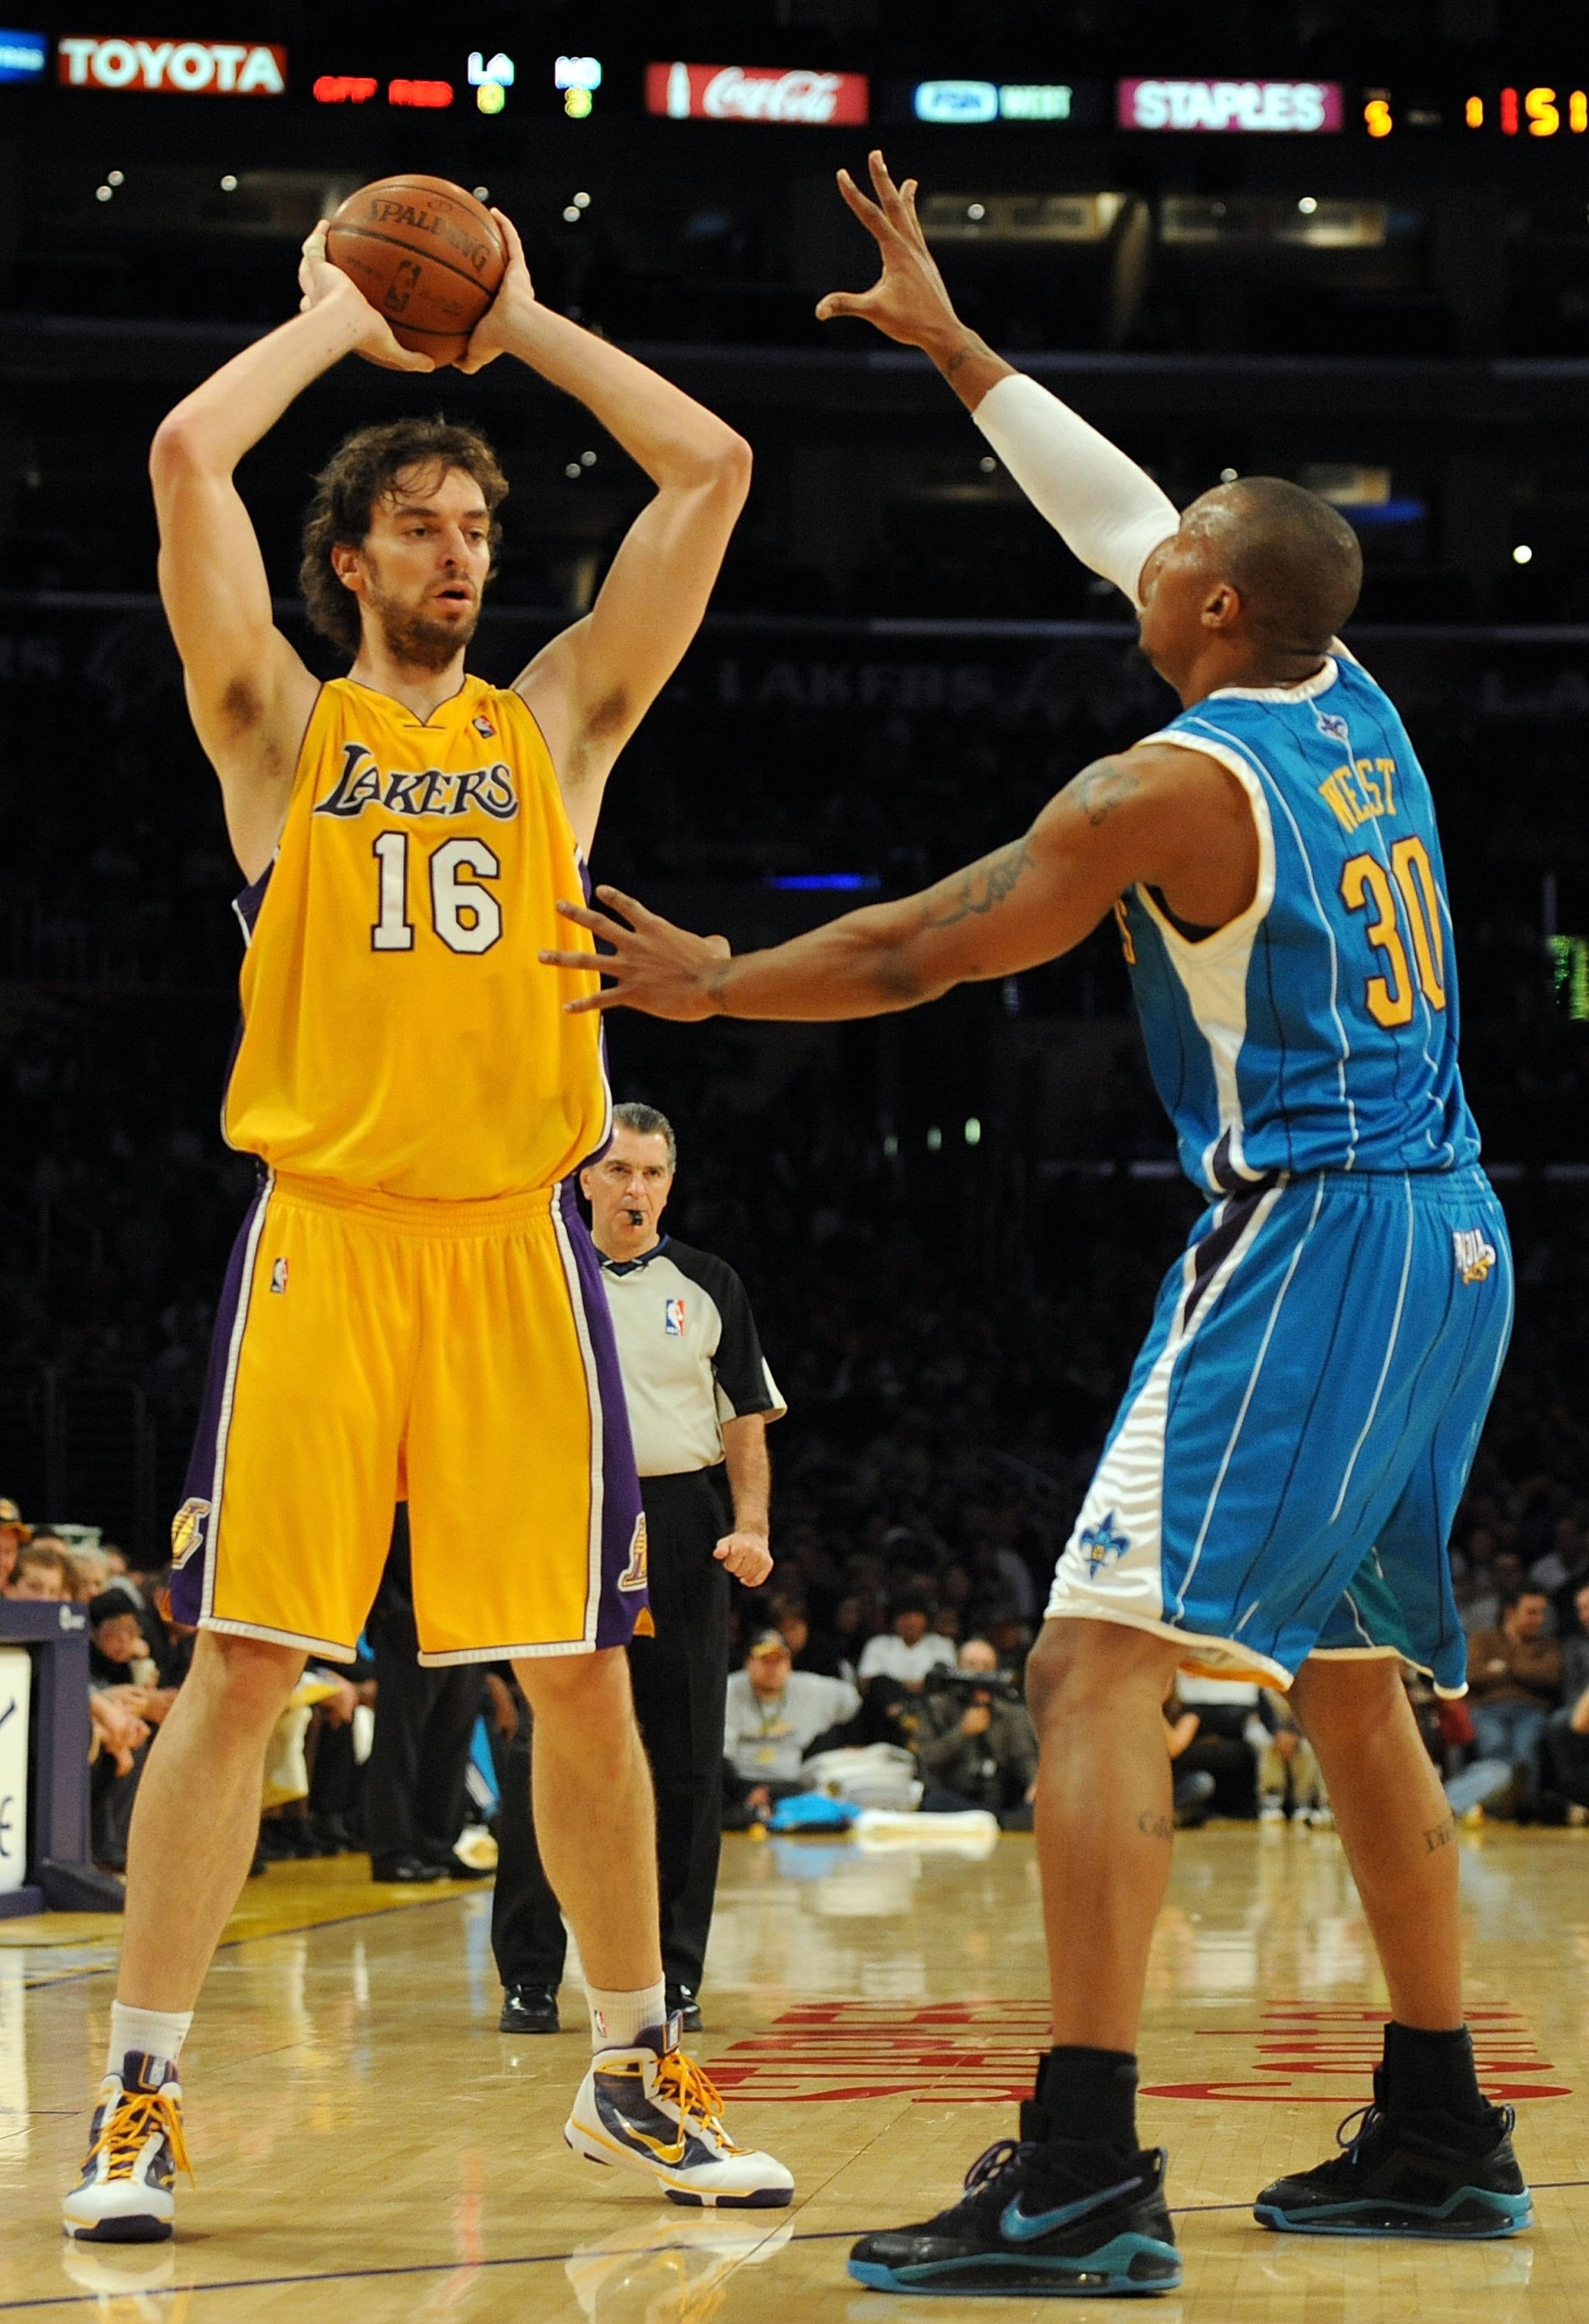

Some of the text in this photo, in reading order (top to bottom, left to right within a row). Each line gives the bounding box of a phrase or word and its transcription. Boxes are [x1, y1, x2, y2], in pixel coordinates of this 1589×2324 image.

[58, 38, 286, 93] TOYOTA
[1133, 81, 1326, 131] STAPLES
[1318, 757, 1397, 834] WEST
[371, 830, 503, 955] 16
[1339, 835, 1446, 1030] 30
